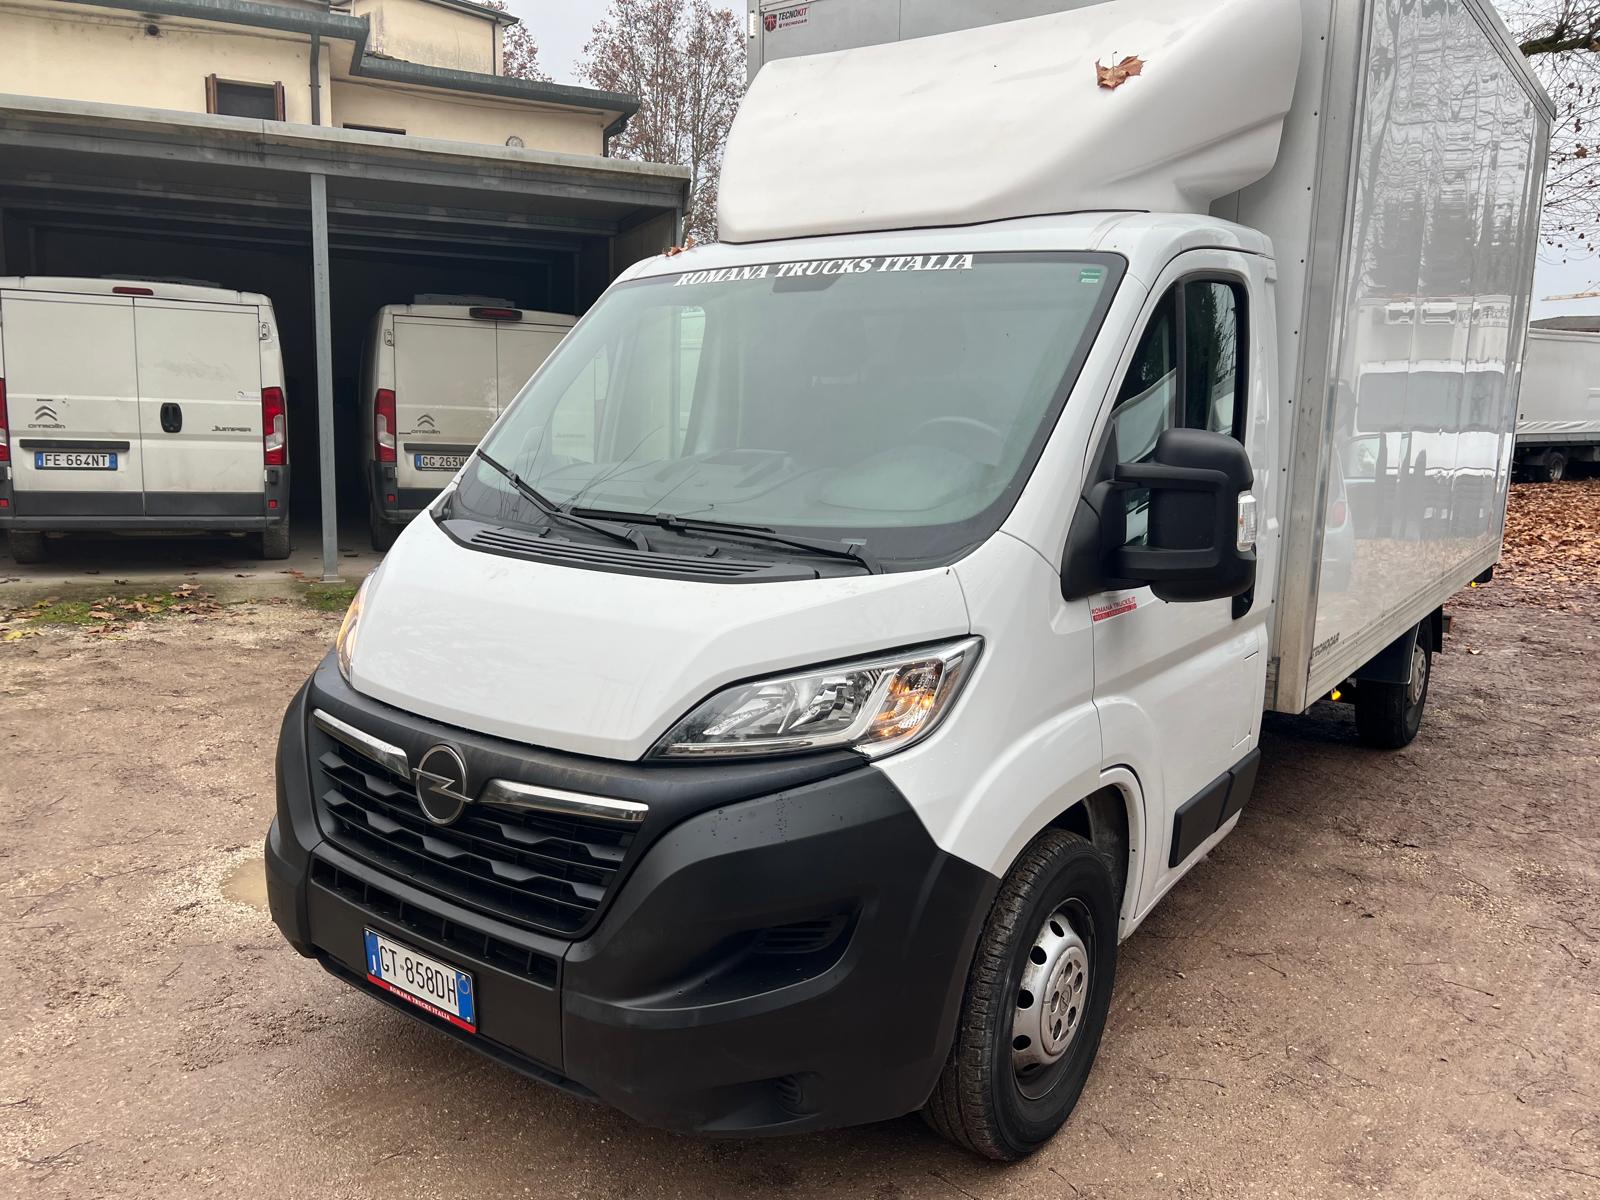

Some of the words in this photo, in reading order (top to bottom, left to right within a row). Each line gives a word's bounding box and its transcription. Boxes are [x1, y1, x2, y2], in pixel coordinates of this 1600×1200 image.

[779, 8, 807, 21] TECNOKIT
[673, 265, 770, 287] ROMANA
[775, 257, 876, 277] TRUCKS
[877, 254, 974, 272] ITALIA
[379, 945, 397, 977] GT
[390, 985, 412, 1003] ROMANA
[411, 996, 432, 1012] TRUCKS
[432, 1007, 450, 1021] ITALIA
